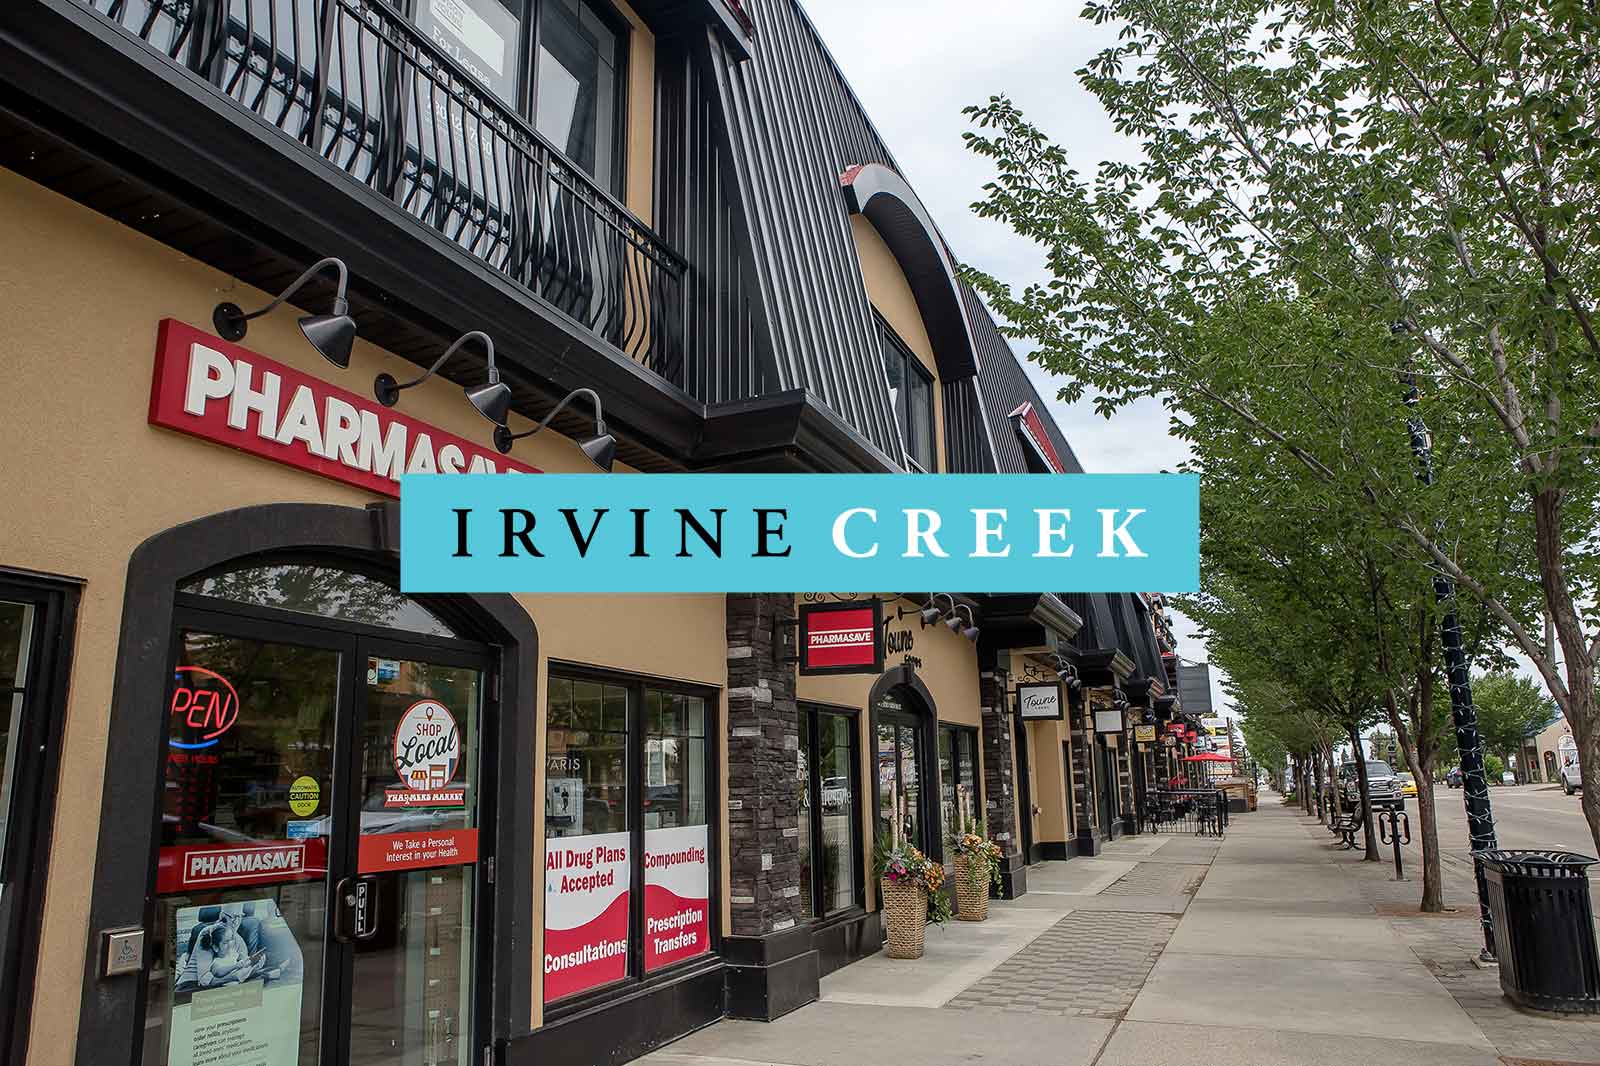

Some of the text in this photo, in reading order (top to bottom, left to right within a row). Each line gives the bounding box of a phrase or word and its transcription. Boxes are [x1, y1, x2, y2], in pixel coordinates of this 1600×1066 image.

[810, 632, 871, 645] PHARMASAVE
[416, 723, 442, 736] SHOP
[395, 723, 459, 770] Local
[546, 758, 581, 770] ARIS
[433, 792, 464, 801] MARKET
[386, 847, 459, 862] Interest in your Health
[392, 840, 404, 850] We
[405, 839, 421, 849] Take
[428, 836, 455, 848] Personal
[190, 850, 300, 877] PHARMASAVE
[546, 846, 626, 871] All Drug Plans
[643, 847, 705, 870] Compounding
[560, 869, 614, 894] Accepted
[357, 886, 366, 933] PULL
[647, 907, 703, 935] Prescription
[654, 930, 697, 955] Transfers
[544, 939, 627, 974] Consultations
